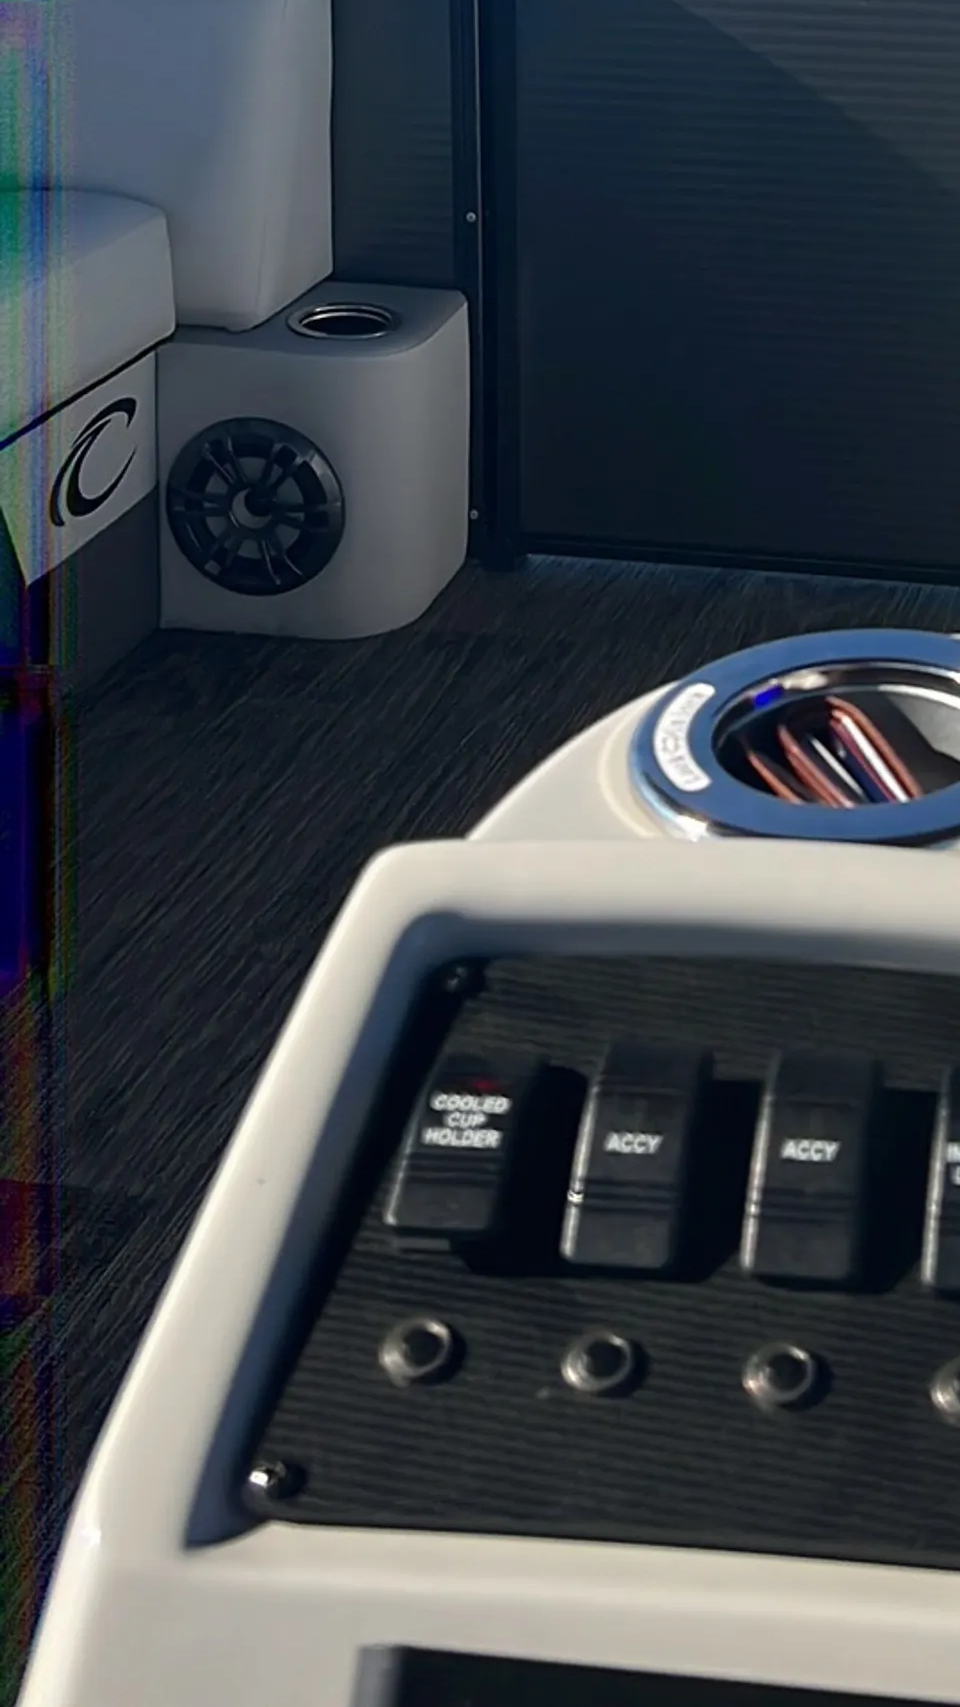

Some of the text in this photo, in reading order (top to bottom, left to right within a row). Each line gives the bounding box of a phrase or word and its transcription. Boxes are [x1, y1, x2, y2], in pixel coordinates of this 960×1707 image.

[431, 1093, 511, 1114] COOLED
[445, 1112, 489, 1127] CUP
[422, 1128, 502, 1148] HOLDER
[604, 1132, 663, 1154] ACCY
[781, 1139, 840, 1162] ACCY
